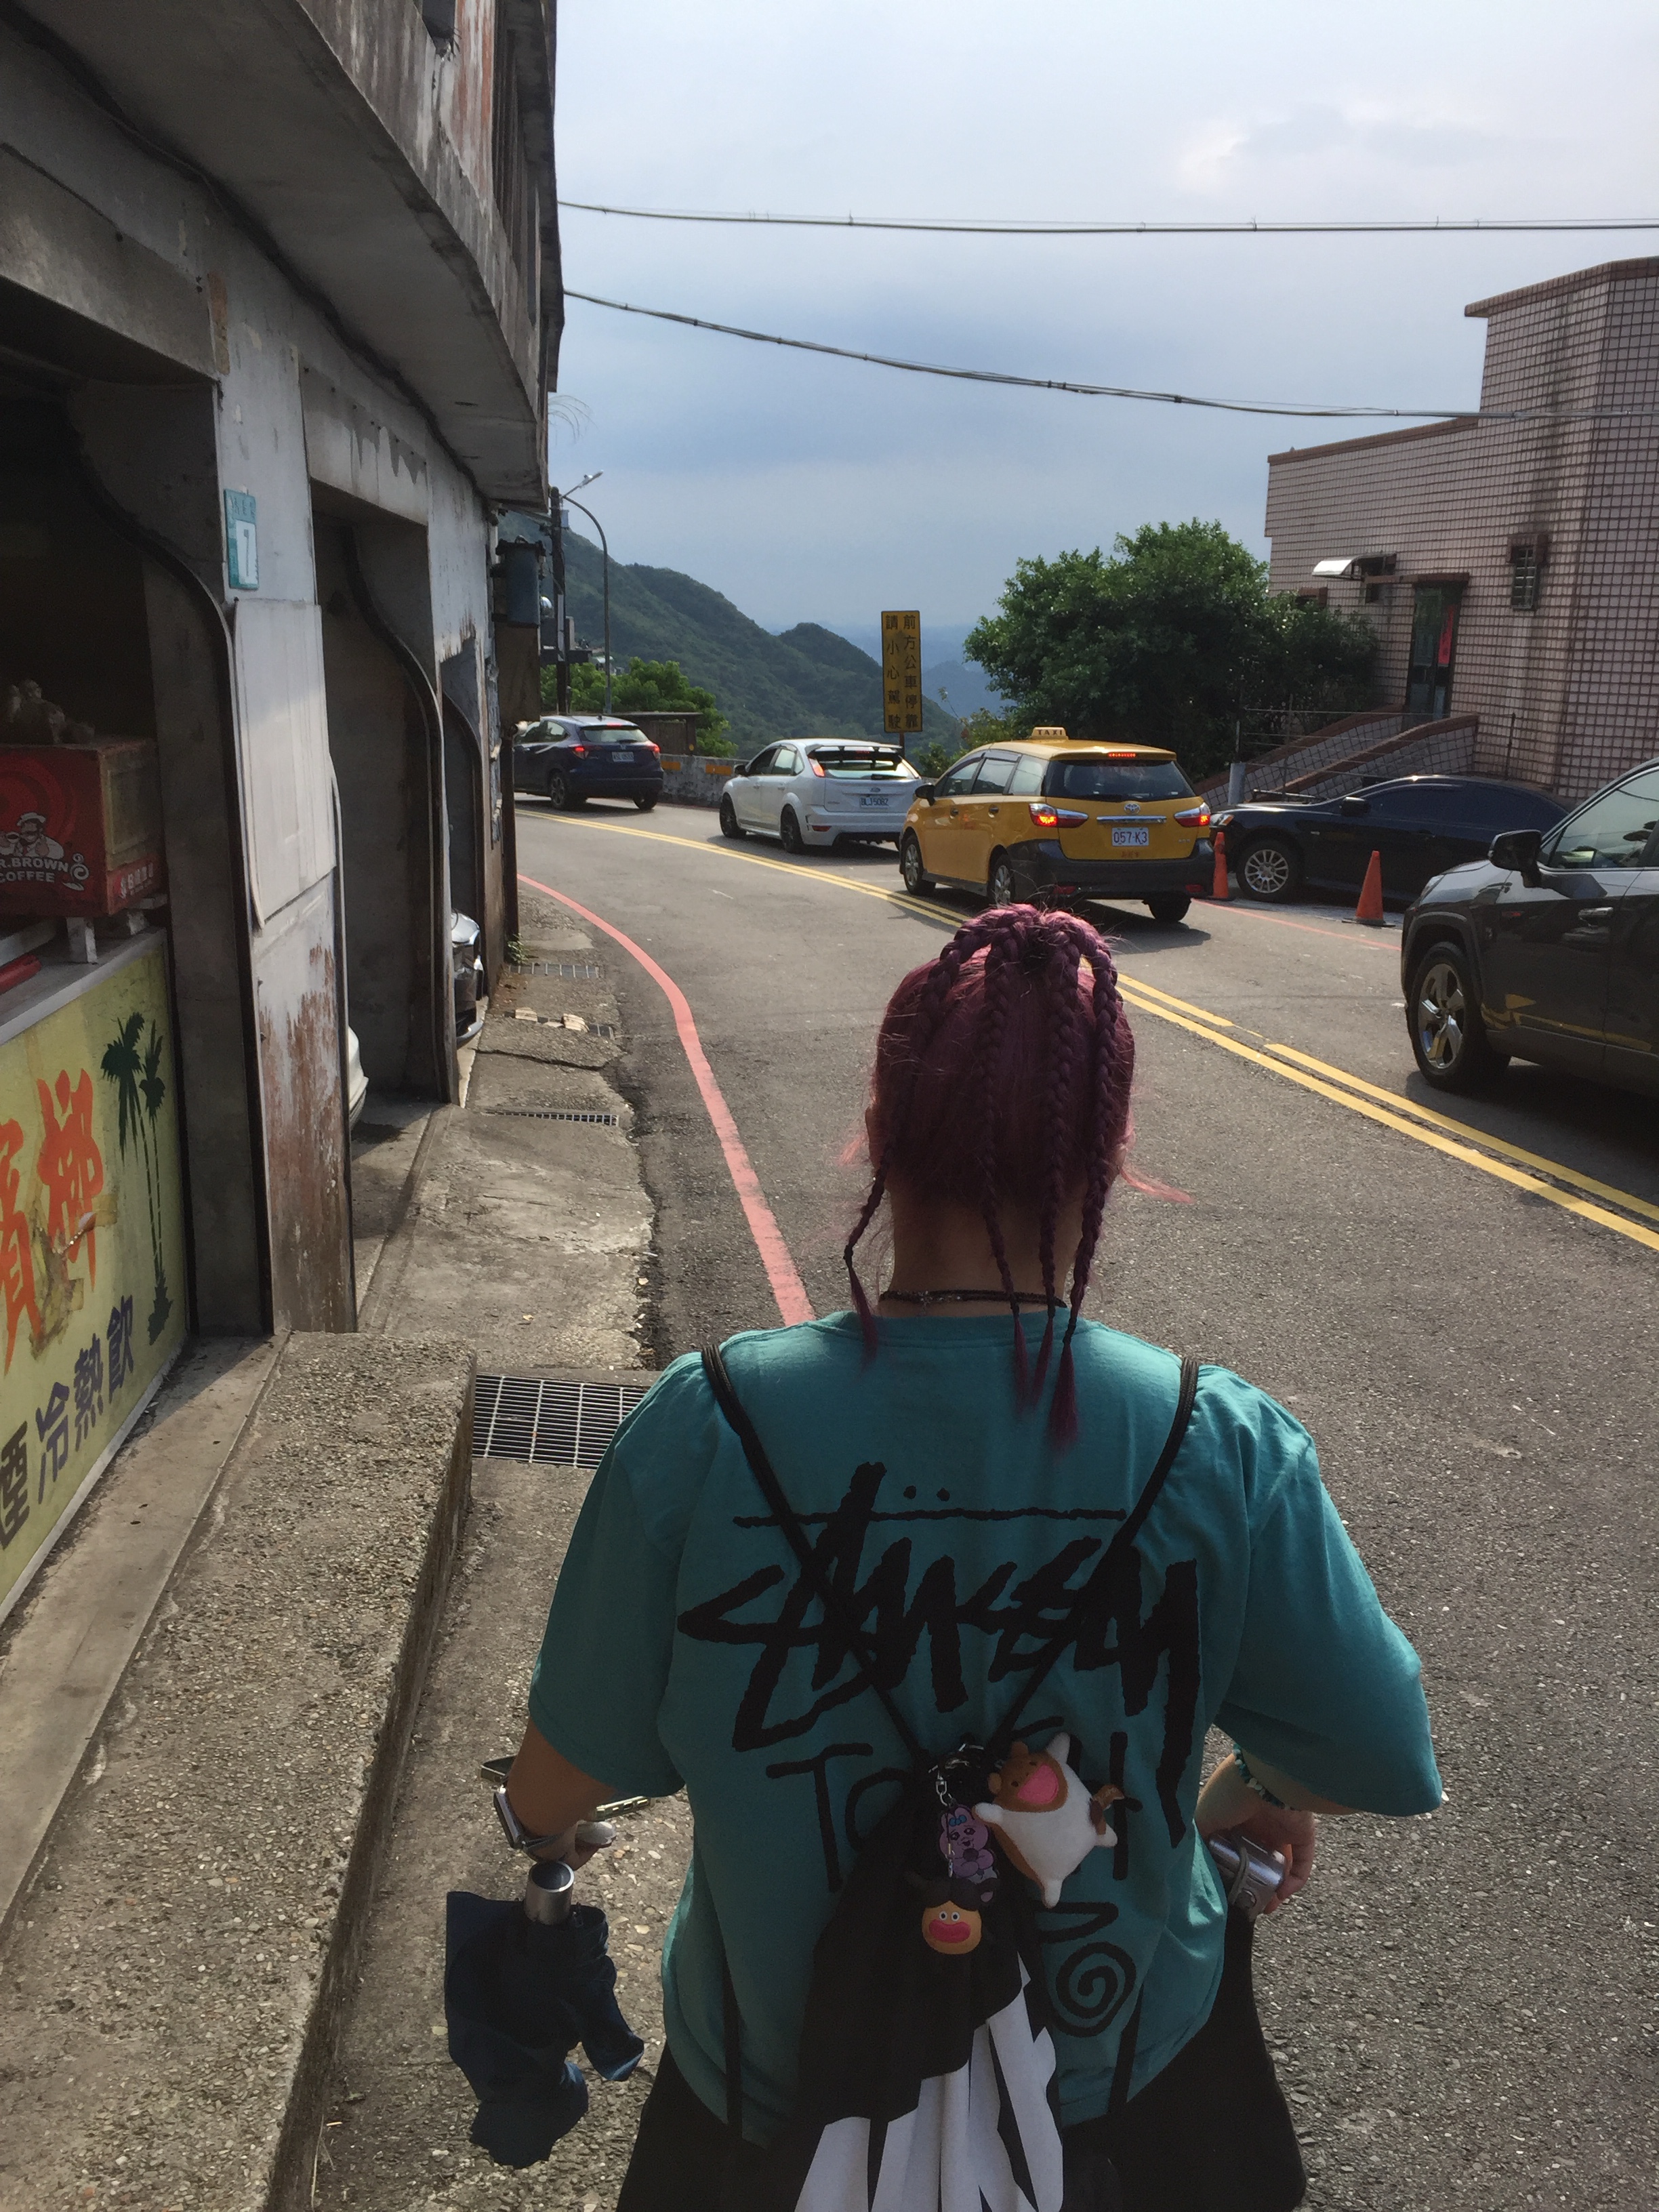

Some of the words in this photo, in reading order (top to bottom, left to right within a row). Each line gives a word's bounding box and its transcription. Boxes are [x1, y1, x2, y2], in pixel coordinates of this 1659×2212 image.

[885, 615, 901, 729] 請小心駕駛
[903, 615, 918, 729] 前方公車停靠
[1113, 831, 1148, 844] 057-K3
